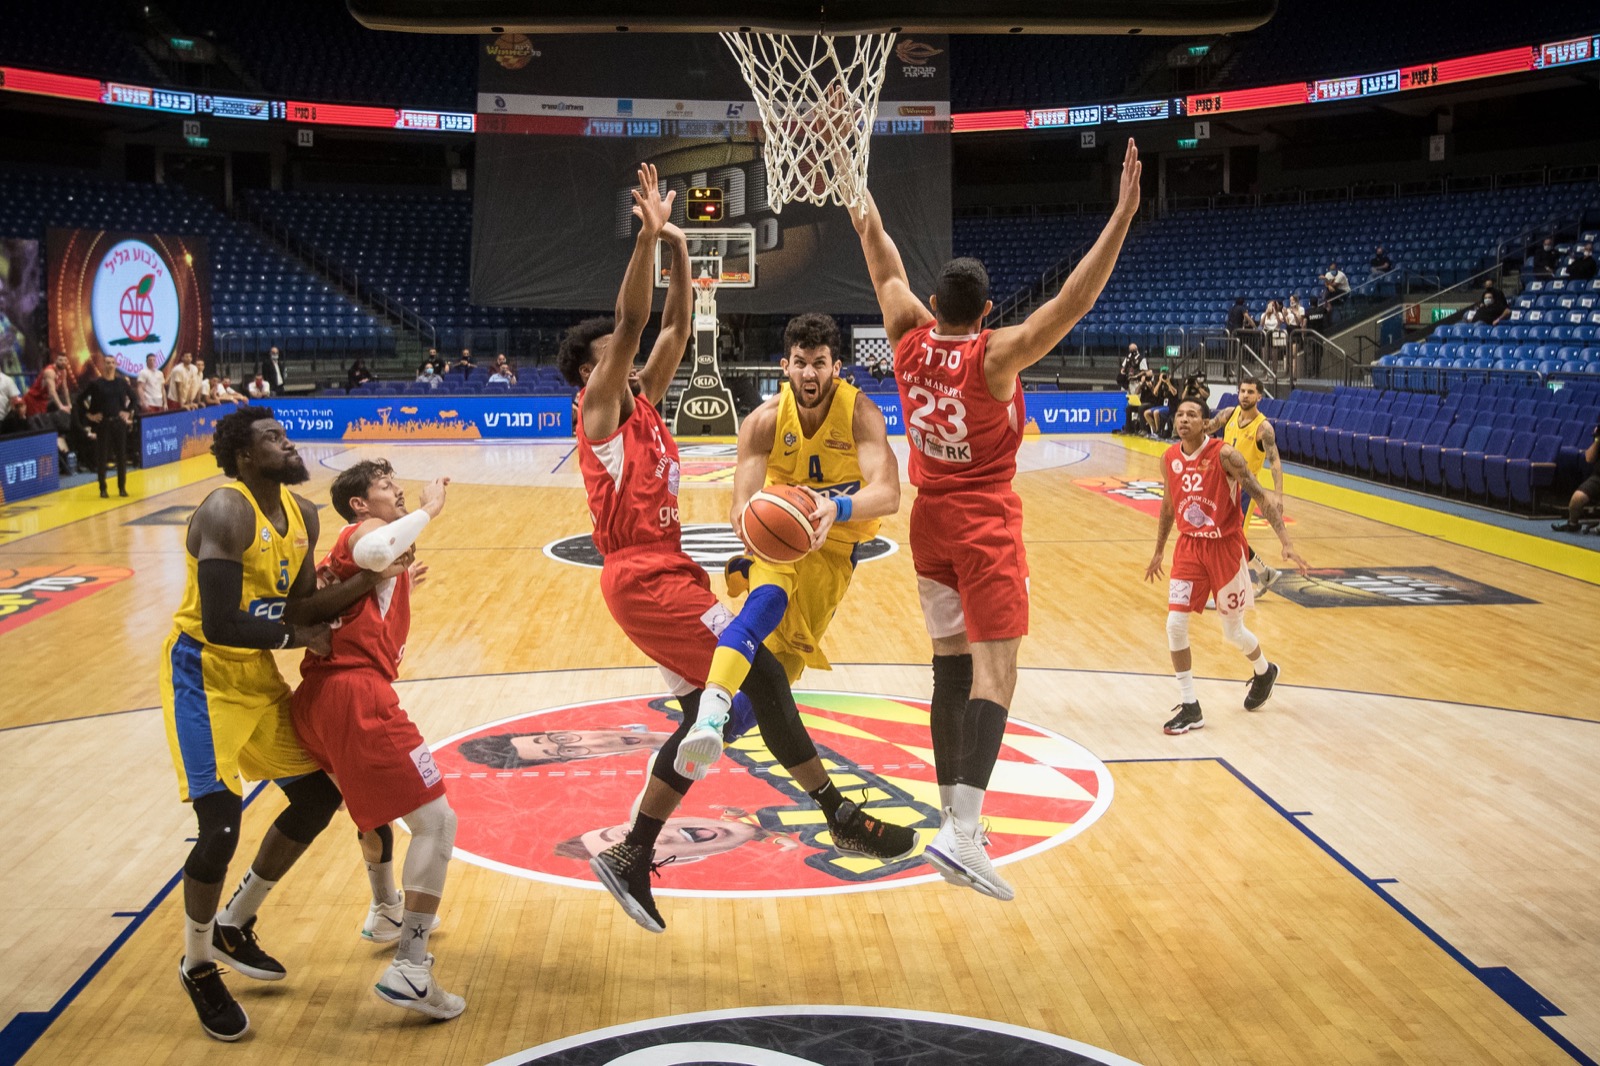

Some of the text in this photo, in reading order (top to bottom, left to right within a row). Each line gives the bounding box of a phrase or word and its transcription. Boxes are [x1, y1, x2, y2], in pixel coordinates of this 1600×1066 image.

[300, 132, 310, 143] 11
[1083, 134, 1094, 145] 12
[698, 378, 714, 386] KIA
[902, 370, 920, 384] LEE
[691, 401, 722, 415] KIA
[908, 385, 968, 443] 23
[1043, 408, 1118, 427] זמן מגרש
[298, 416, 333, 431] מפעל
[484, 411, 561, 431] זמן מגרש
[945, 444, 970, 460] RK
[5, 459, 37, 485] מגרש
[809, 454, 824, 482] 4
[1181, 472, 1203, 493] 32
[277, 559, 289, 591] 5
[1227, 589, 1245, 610] 32
[254, 601, 287, 620] FO
